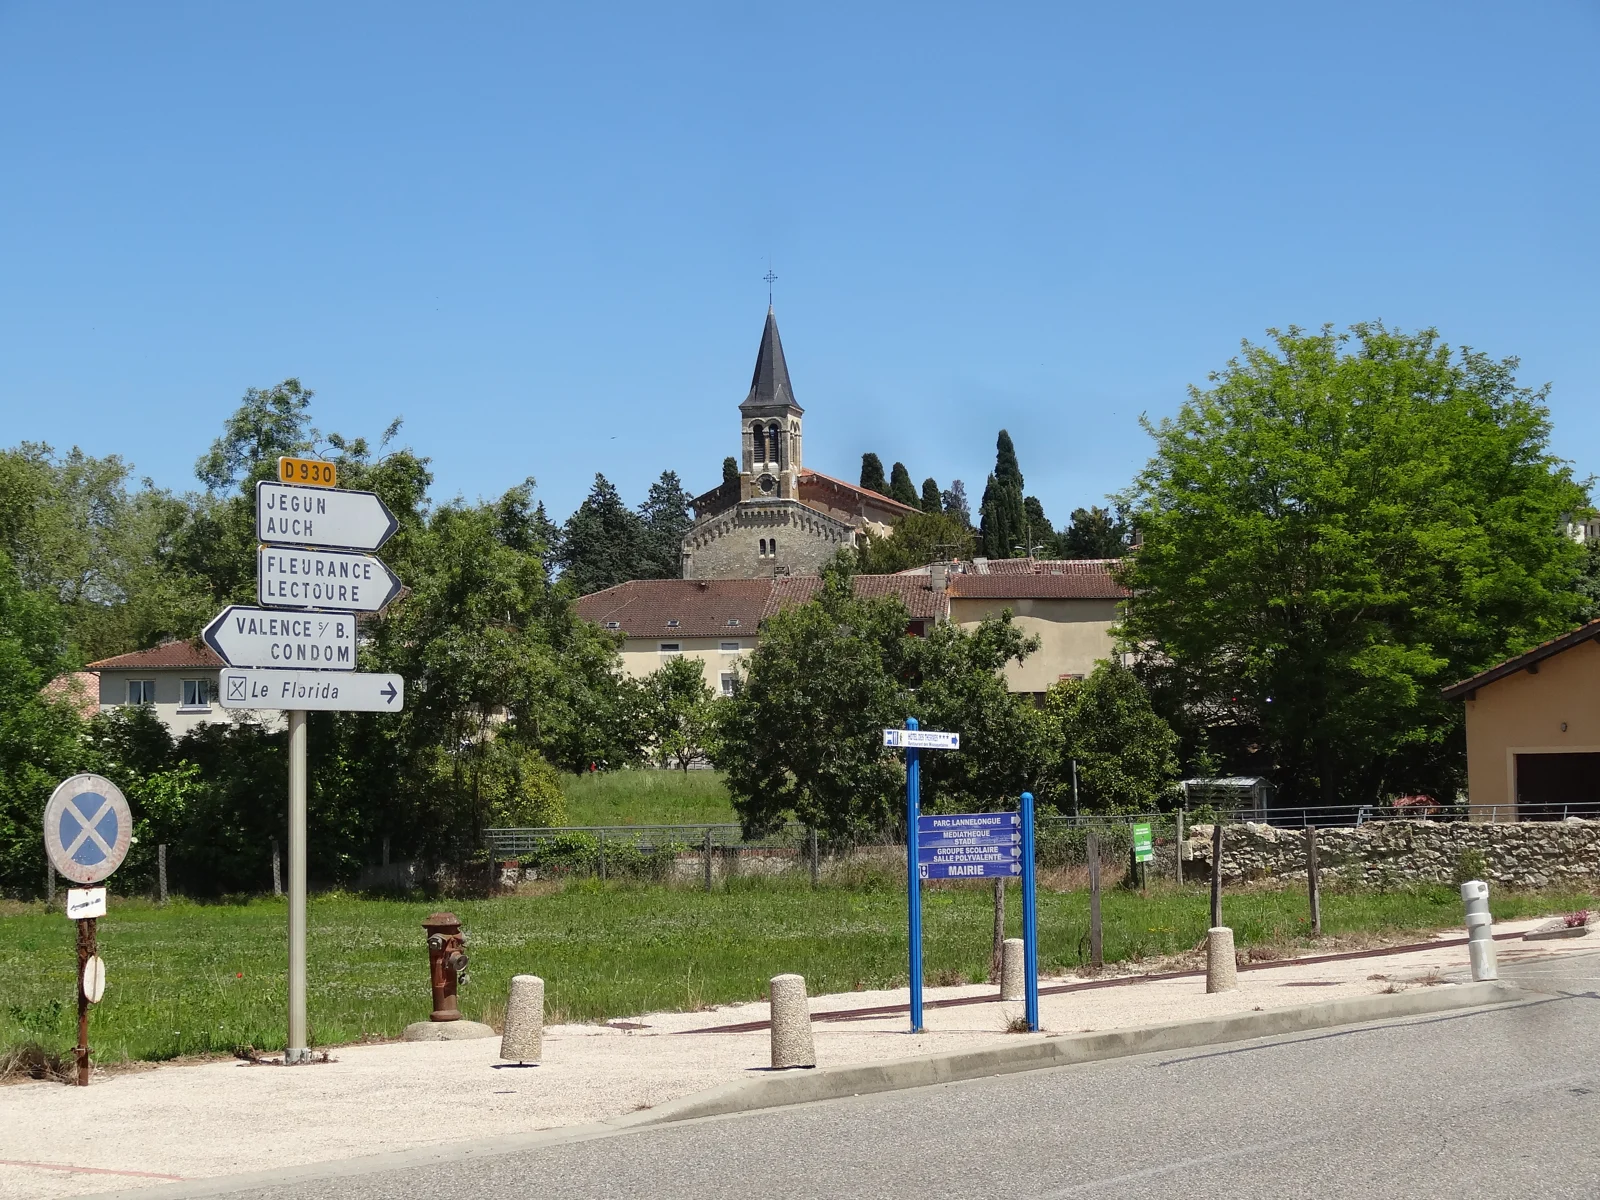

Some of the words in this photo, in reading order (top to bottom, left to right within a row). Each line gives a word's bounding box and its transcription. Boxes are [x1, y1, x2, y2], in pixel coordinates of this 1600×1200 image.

[286, 461, 294, 478] D
[300, 463, 332, 483] 930
[267, 493, 326, 515] JEGUN
[267, 518, 313, 537] AUCH
[267, 556, 371, 580] FLEURANCE
[267, 580, 360, 602] LECTOURE
[236, 617, 312, 637] VALENCE
[270, 643, 349, 662] CONDOM
[251, 681, 268, 698] Le
[281, 681, 339, 699] Florida
[952, 818, 1001, 826] LANNELONGUE
[943, 830, 990, 839] MEDIATHEQUE
[933, 855, 954, 863] SALLE
[955, 853, 1002, 862] POLYVALENTE
[937, 847, 964, 855] GROUPE
[965, 846, 998, 854] SCOLAIRE
[948, 865, 984, 876] MAIRIE
